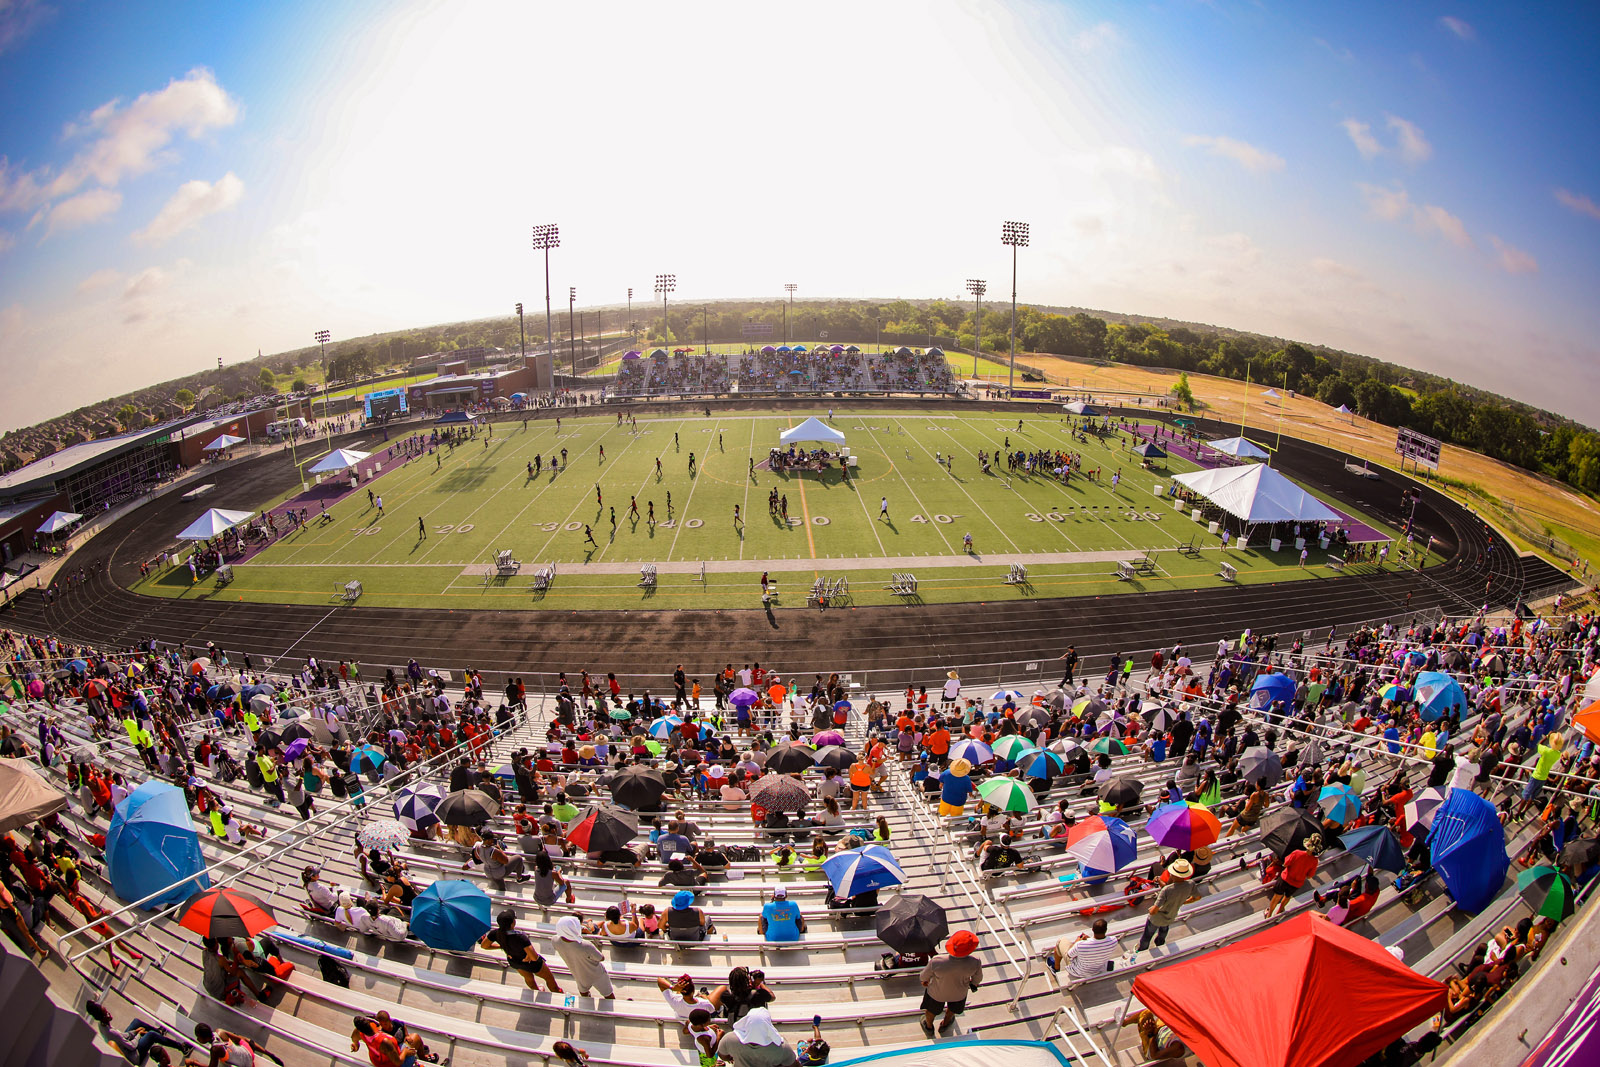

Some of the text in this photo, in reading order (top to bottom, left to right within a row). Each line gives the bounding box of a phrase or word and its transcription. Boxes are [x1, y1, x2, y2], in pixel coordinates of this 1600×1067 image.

[785, 516, 831, 526] 50
[910, 514, 954, 524] 40
[1025, 512, 1065, 522] 30
[1125, 511, 1162, 521] 20
[541, 521, 584, 532] 30
[658, 518, 705, 529] 40
[435, 524, 475, 534] 20
